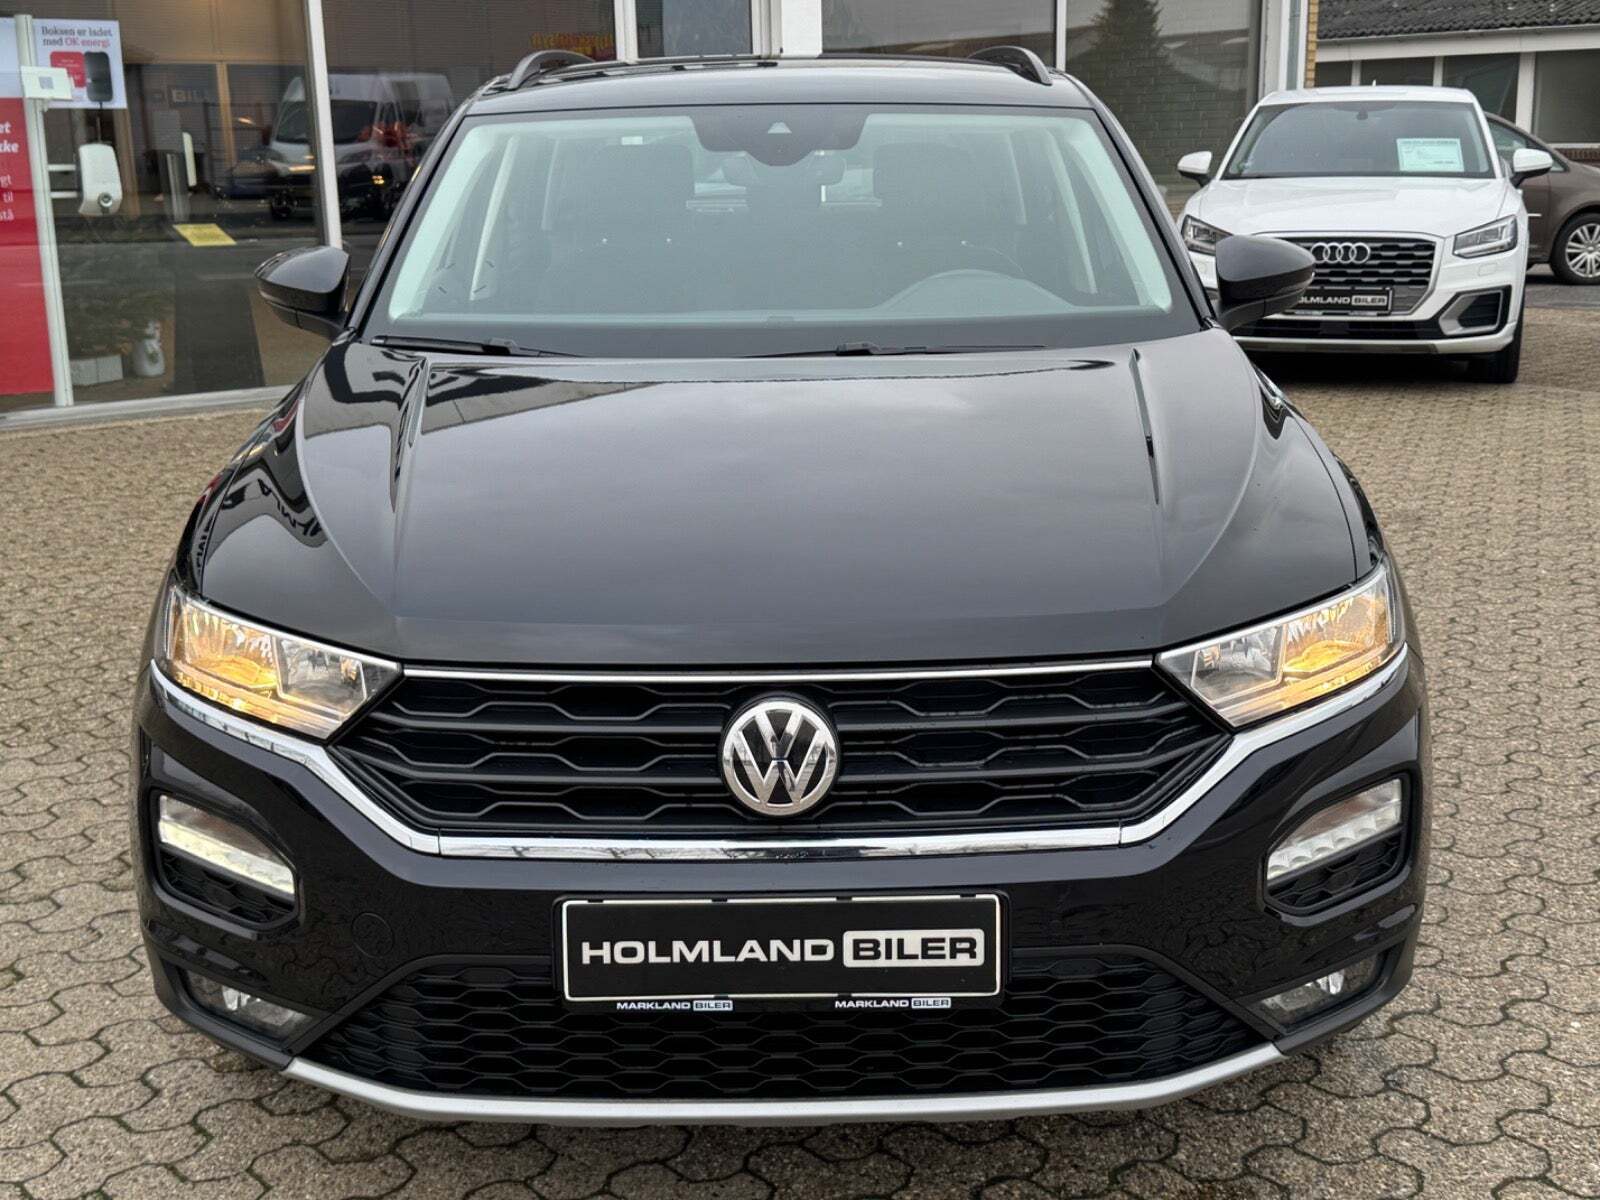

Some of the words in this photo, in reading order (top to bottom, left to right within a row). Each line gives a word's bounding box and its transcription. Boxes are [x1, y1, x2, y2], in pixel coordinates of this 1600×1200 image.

[41, 26, 75, 36] Boksen
[77, 28, 87, 36] er
[43, 37, 63, 47] med
[65, 38, 79, 47] OK
[81, 38, 110, 49] energi
[581, 939, 835, 965] HOLMLAND
[852, 936, 977, 961] BILER
[616, 1001, 690, 1010] MARKLAND
[694, 1002, 732, 1010] BILER
[834, 999, 909, 1009] MARKLAND
[912, 999, 950, 1008] BILER
